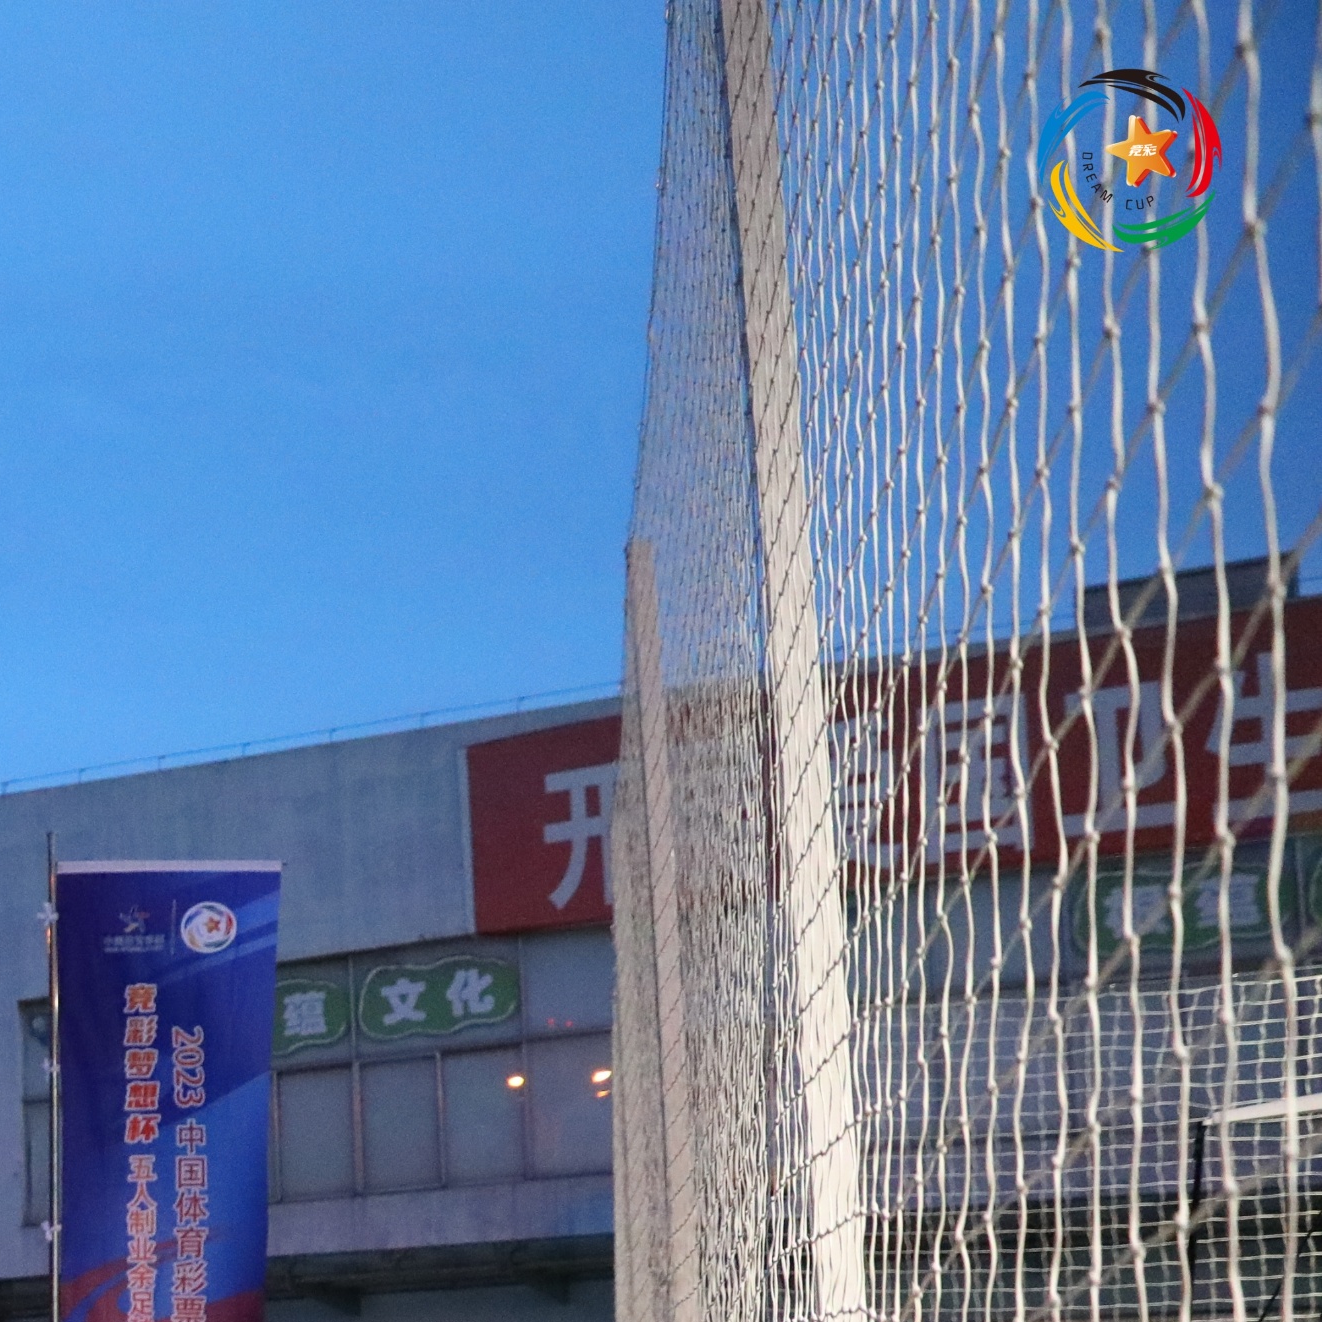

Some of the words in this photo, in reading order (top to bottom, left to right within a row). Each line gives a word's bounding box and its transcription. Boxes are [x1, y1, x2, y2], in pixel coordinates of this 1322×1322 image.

[123, 982, 160, 1144] 竞彩梦想杯
[171, 1025, 206, 1108] 2023
